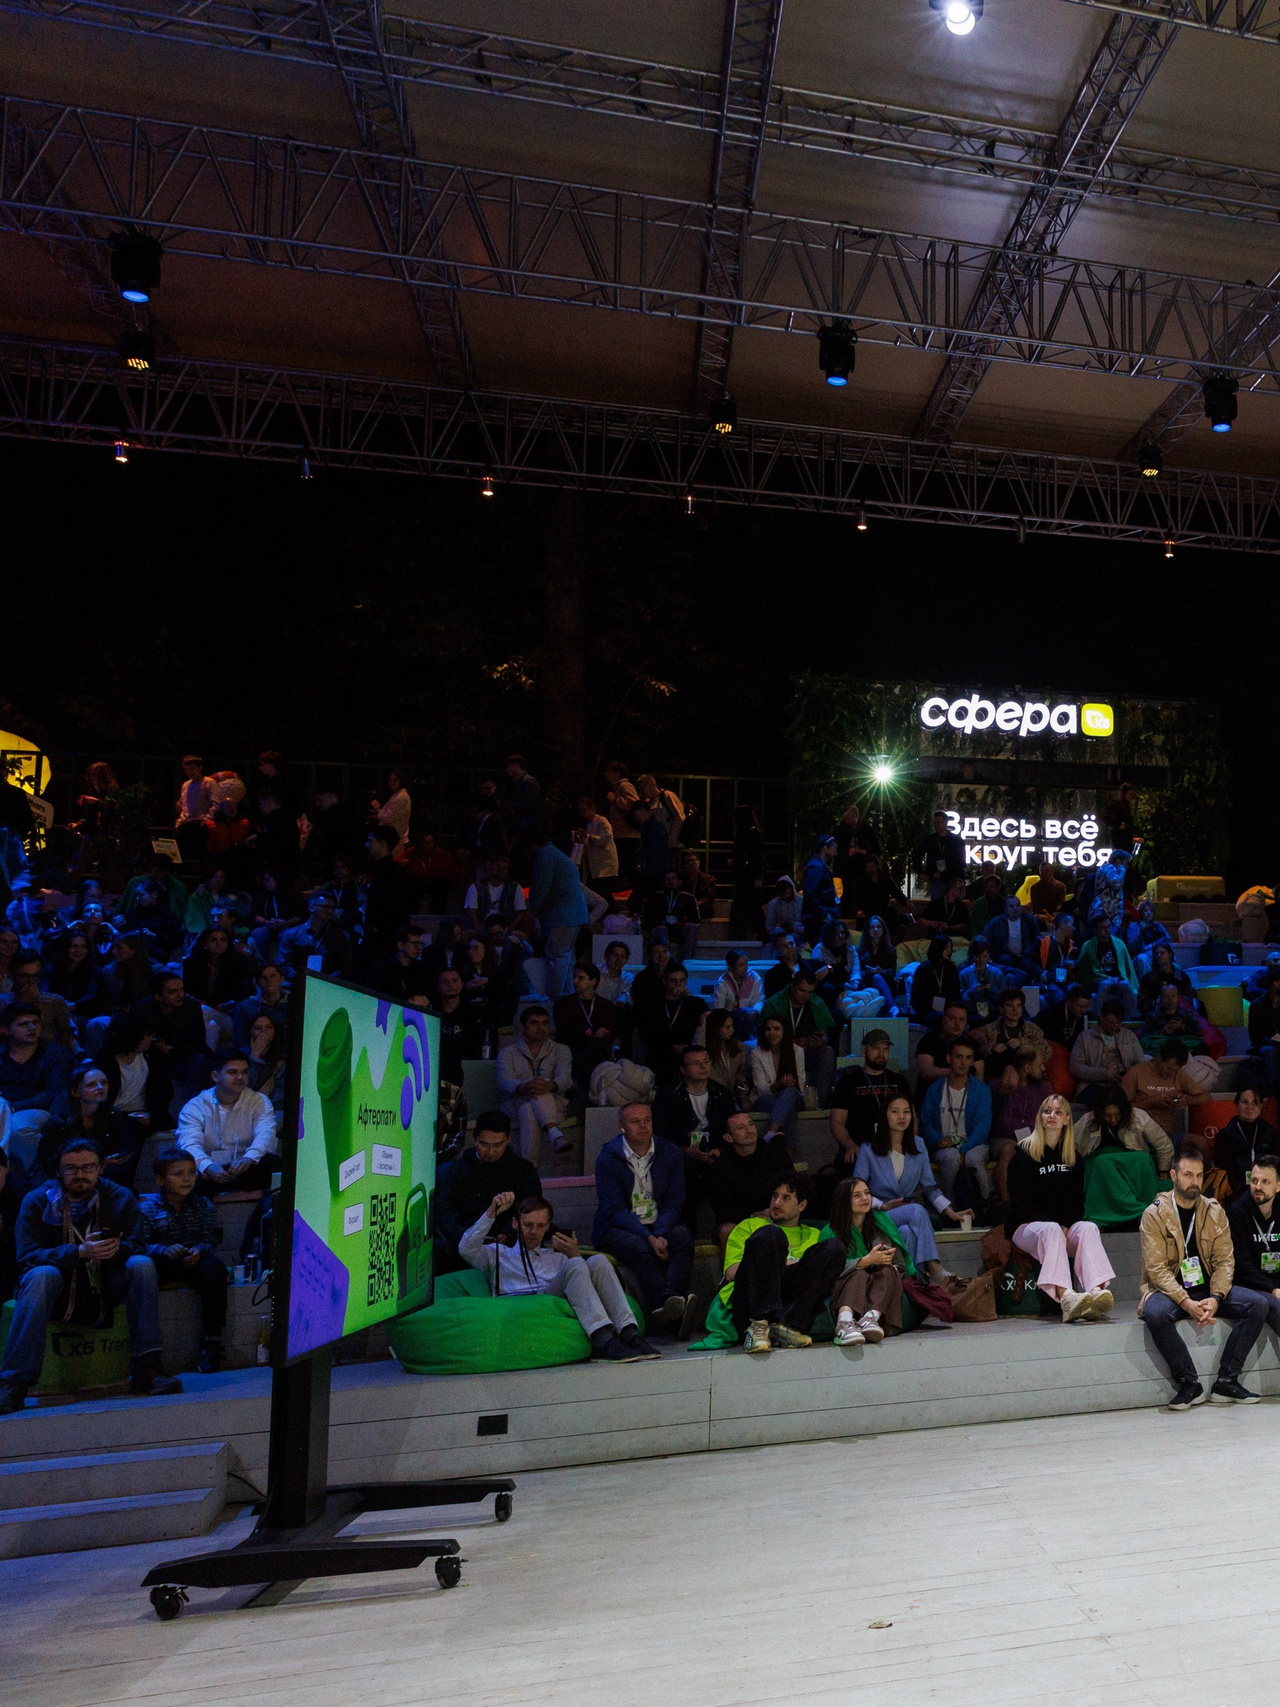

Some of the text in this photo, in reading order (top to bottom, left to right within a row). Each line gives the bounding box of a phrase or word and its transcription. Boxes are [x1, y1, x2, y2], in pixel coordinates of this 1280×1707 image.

[920, 694, 1077, 737] сфера
[944, 811, 1099, 841] Здесь всё
[965, 841, 1113, 871] круг тебя
[357, 1102, 397, 1131] Афтерпати
[1039, 1166, 1047, 1175] Я
[1056, 1163, 1069, 1172] ТЕ
[100, 1338, 133, 1354] Tran
